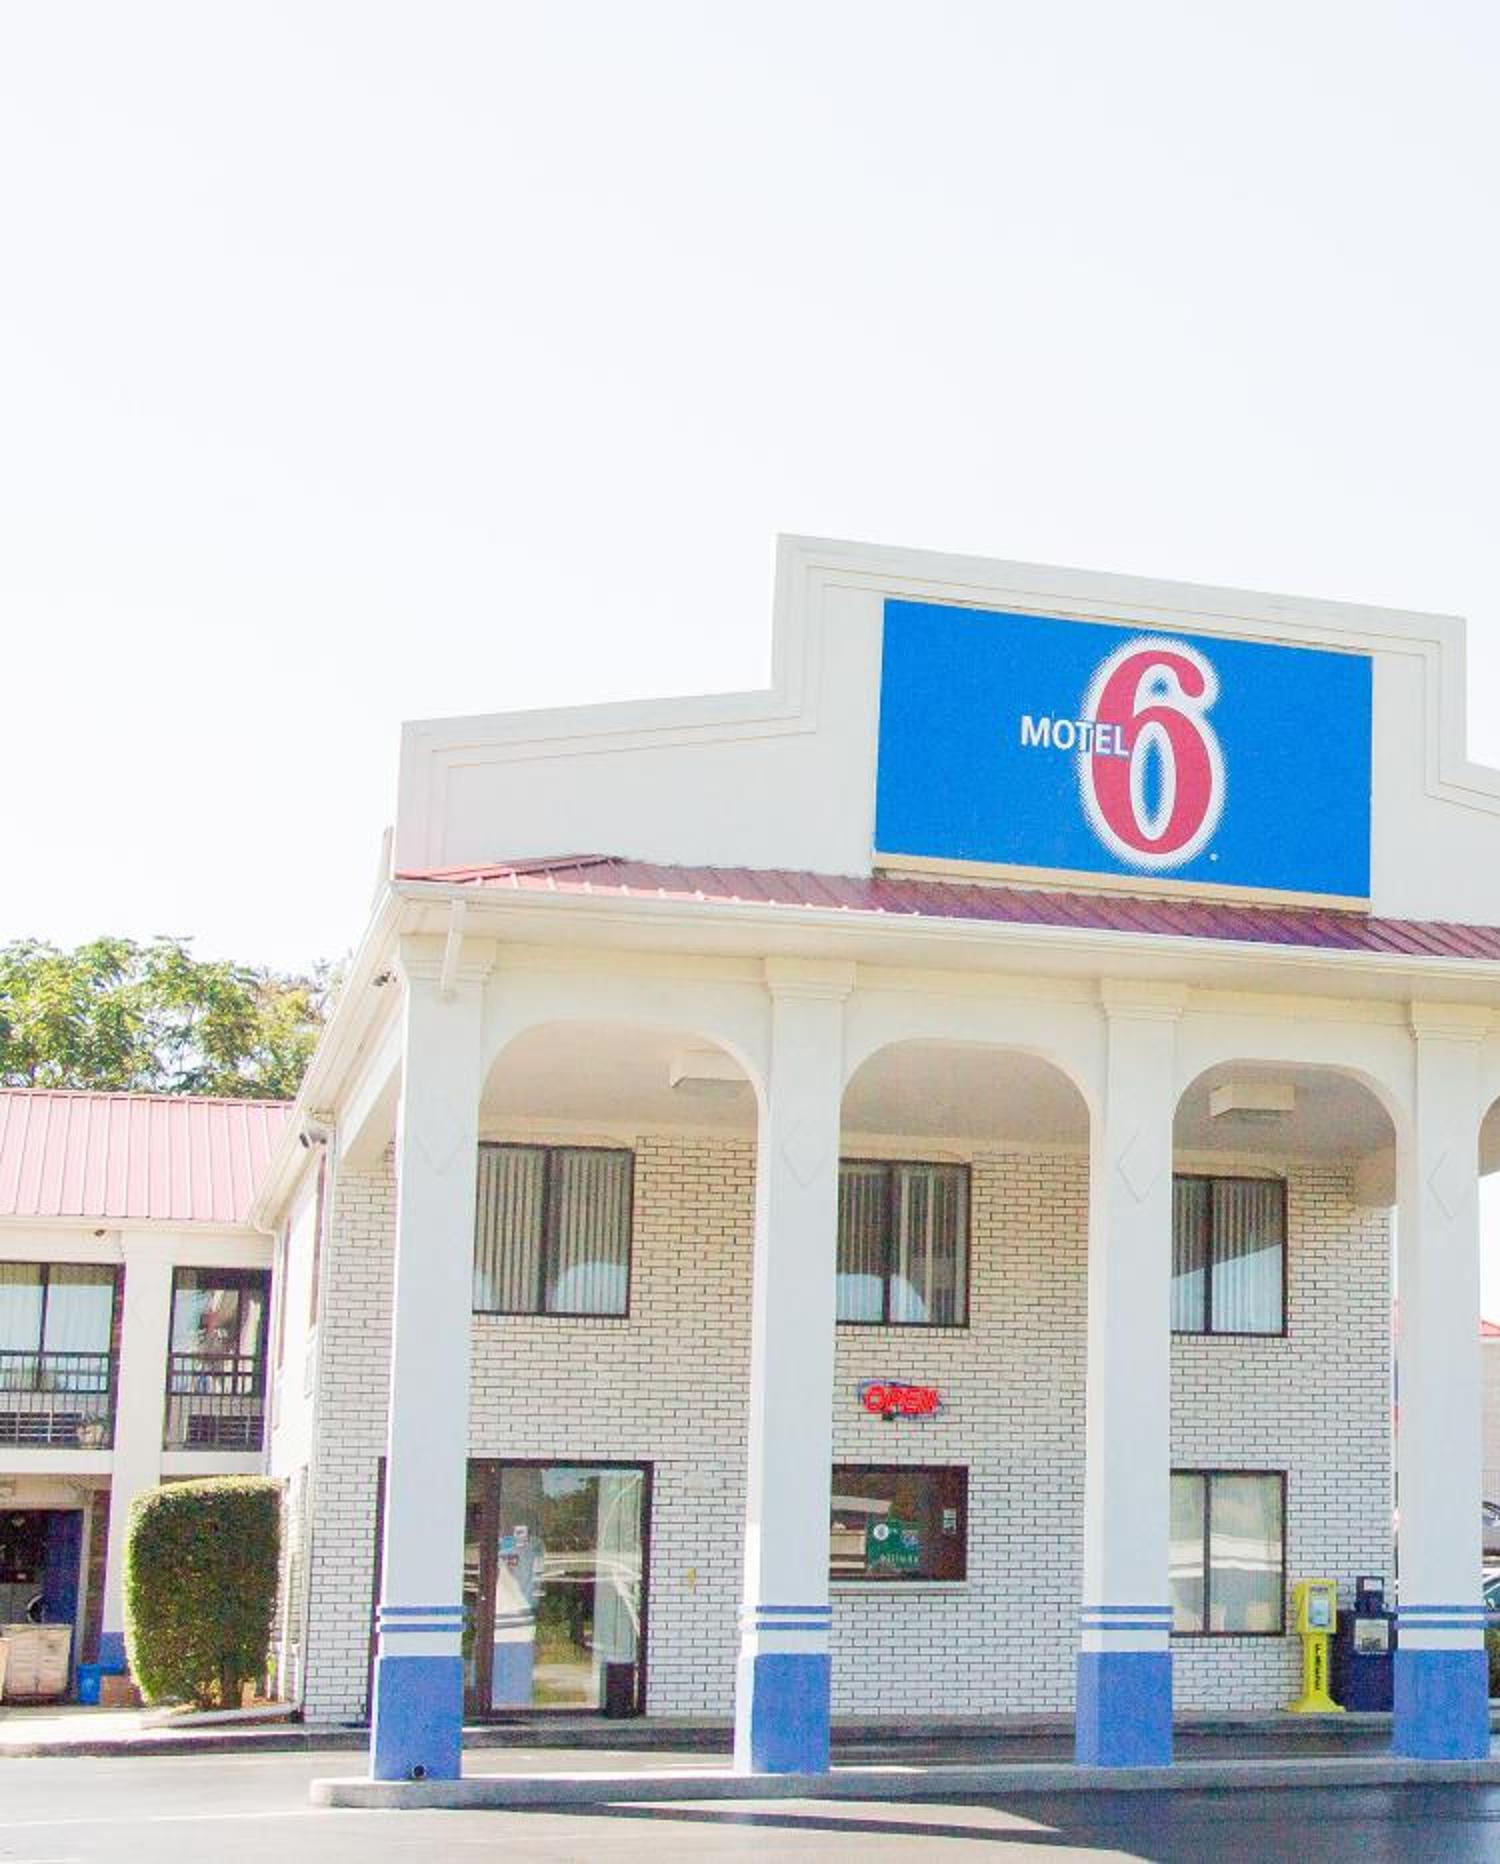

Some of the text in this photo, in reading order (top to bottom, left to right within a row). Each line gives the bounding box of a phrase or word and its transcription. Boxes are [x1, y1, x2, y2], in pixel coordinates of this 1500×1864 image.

[1020, 649, 1214, 855] MOTEL 6
[864, 1384, 939, 1415] OPEN
